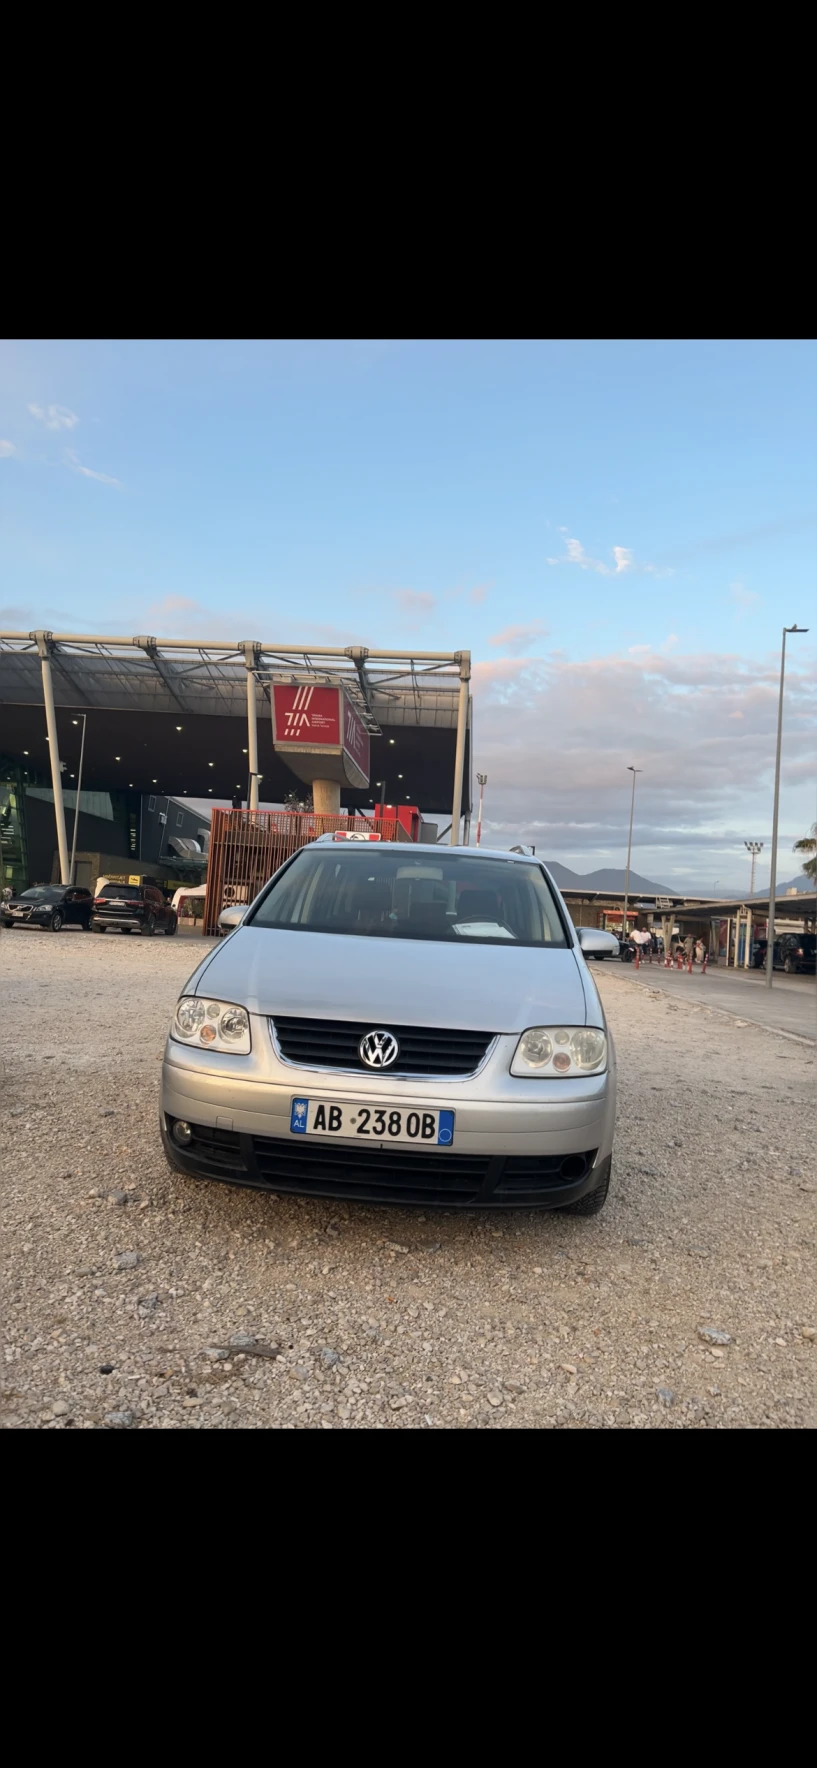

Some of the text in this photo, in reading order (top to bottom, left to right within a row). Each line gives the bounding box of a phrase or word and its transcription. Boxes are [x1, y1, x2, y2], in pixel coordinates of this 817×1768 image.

[293, 1120, 305, 1128] AL
[313, 1104, 342, 1132] AB
[356, 1108, 402, 1136] 238
